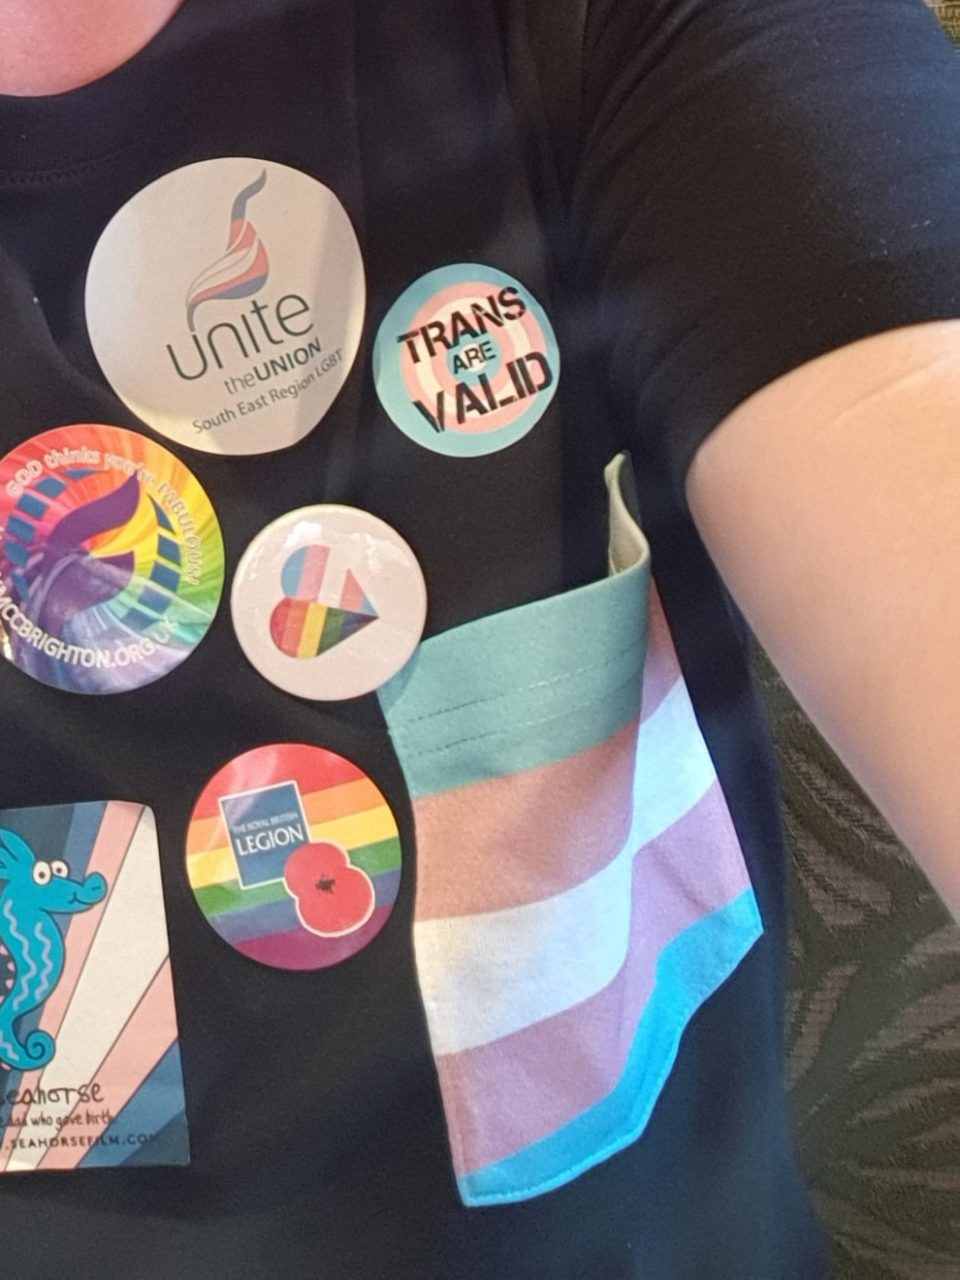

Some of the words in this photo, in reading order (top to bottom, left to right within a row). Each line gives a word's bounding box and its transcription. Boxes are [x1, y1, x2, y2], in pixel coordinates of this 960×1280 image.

[396, 286, 526, 364] TRANS
[452, 340, 496, 375] ARE
[192, 408, 237, 434] South
[237, 395, 269, 416] East
[268, 372, 316, 404] Region
[315, 348, 343, 378] LGBT
[412, 351, 553, 434] VALID
[6, 459, 43, 498] GOD
[236, 823, 304, 856] LEGION
[31, 1111, 53, 1127] who
[55, 1114, 84, 1132] gave
